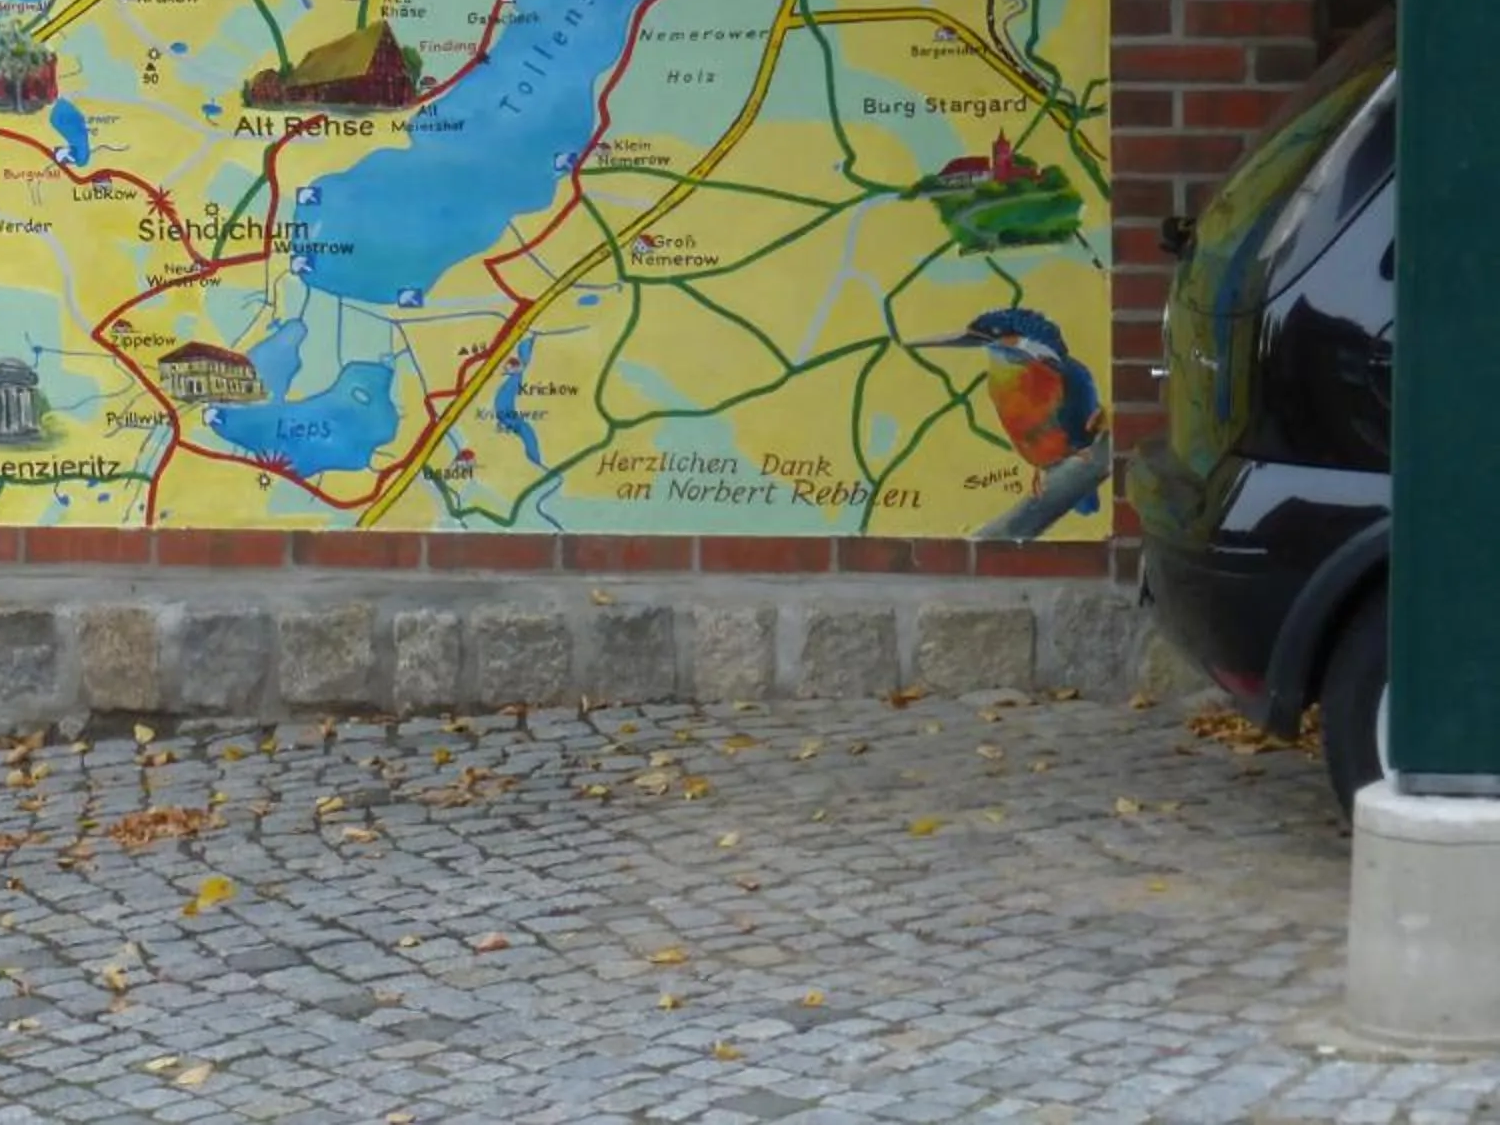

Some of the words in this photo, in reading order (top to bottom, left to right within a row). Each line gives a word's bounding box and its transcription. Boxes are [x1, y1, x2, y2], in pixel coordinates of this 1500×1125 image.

[639, 27, 771, 44] Nemerower
[666, 69, 716, 84] Holz
[863, 98, 916, 118] Burg
[925, 97, 1028, 118] Stargard
[234, 116, 275, 137] Alt
[285, 116, 374, 137] Rehse
[615, 139, 652, 151] Klein
[138, 215, 310, 241] Siehdichum
[274, 239, 354, 254] Wustrow
[652, 235, 696, 249] Groß
[631, 252, 719, 267] Nemerow
[517, 383, 579, 396] Krickow
[277, 418, 332, 440] Lieps
[597, 450, 738, 476] Herzlichen
[760, 453, 832, 477] Dank
[616, 482, 652, 501] an
[667, 479, 778, 504] Norbert
[791, 479, 922, 508] Rebben
